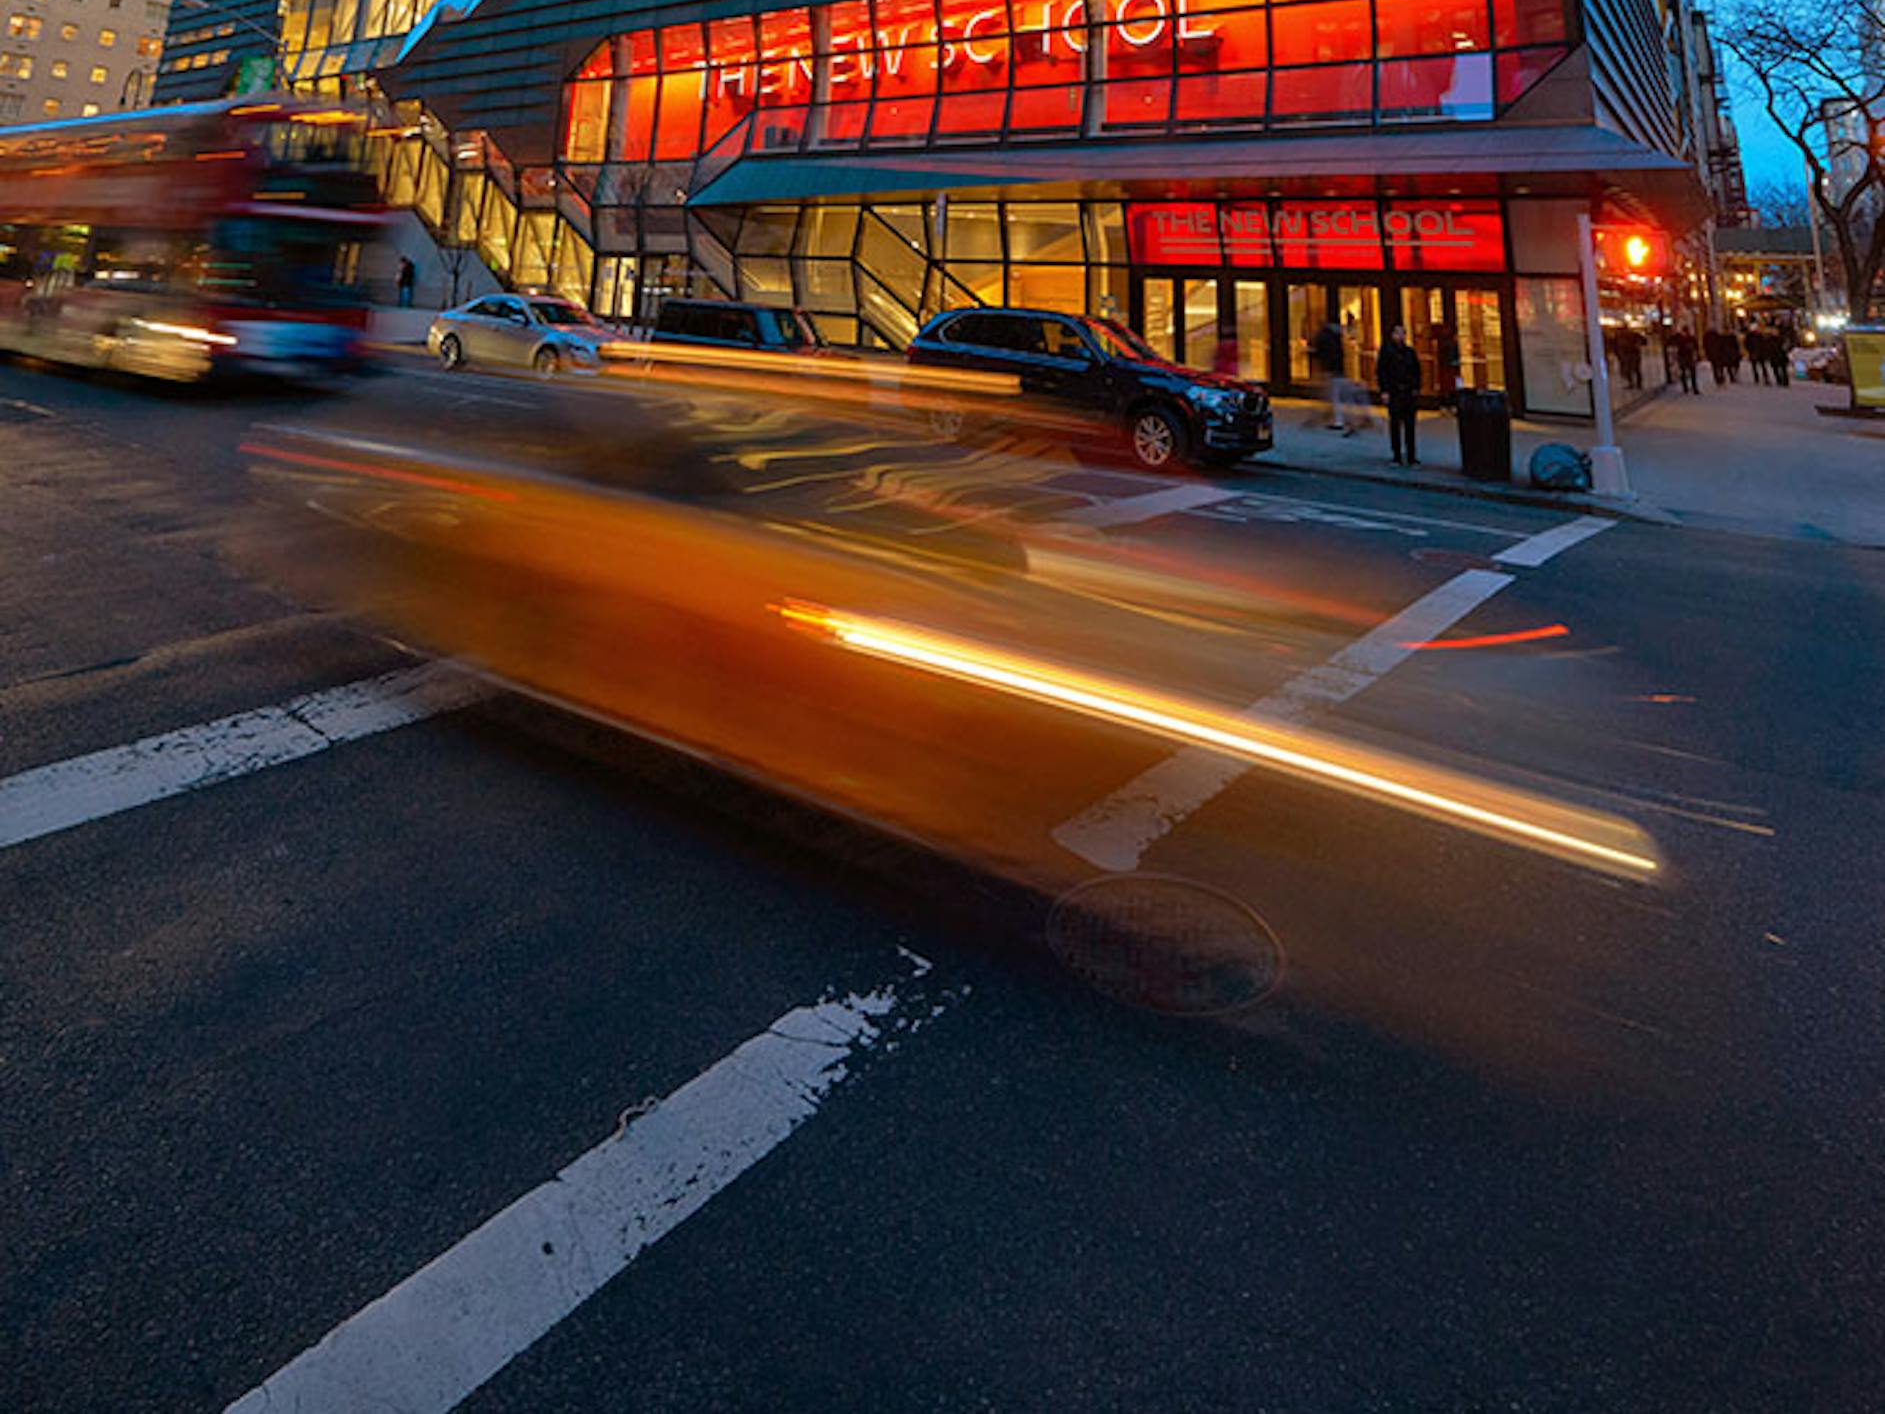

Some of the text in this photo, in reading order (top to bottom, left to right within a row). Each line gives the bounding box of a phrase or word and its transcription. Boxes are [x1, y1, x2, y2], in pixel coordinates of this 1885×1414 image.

[693, 49, 778, 99] THE
[788, 27, 909, 89] NEW
[1152, 210, 1475, 235] THE NEW SCHOOL
